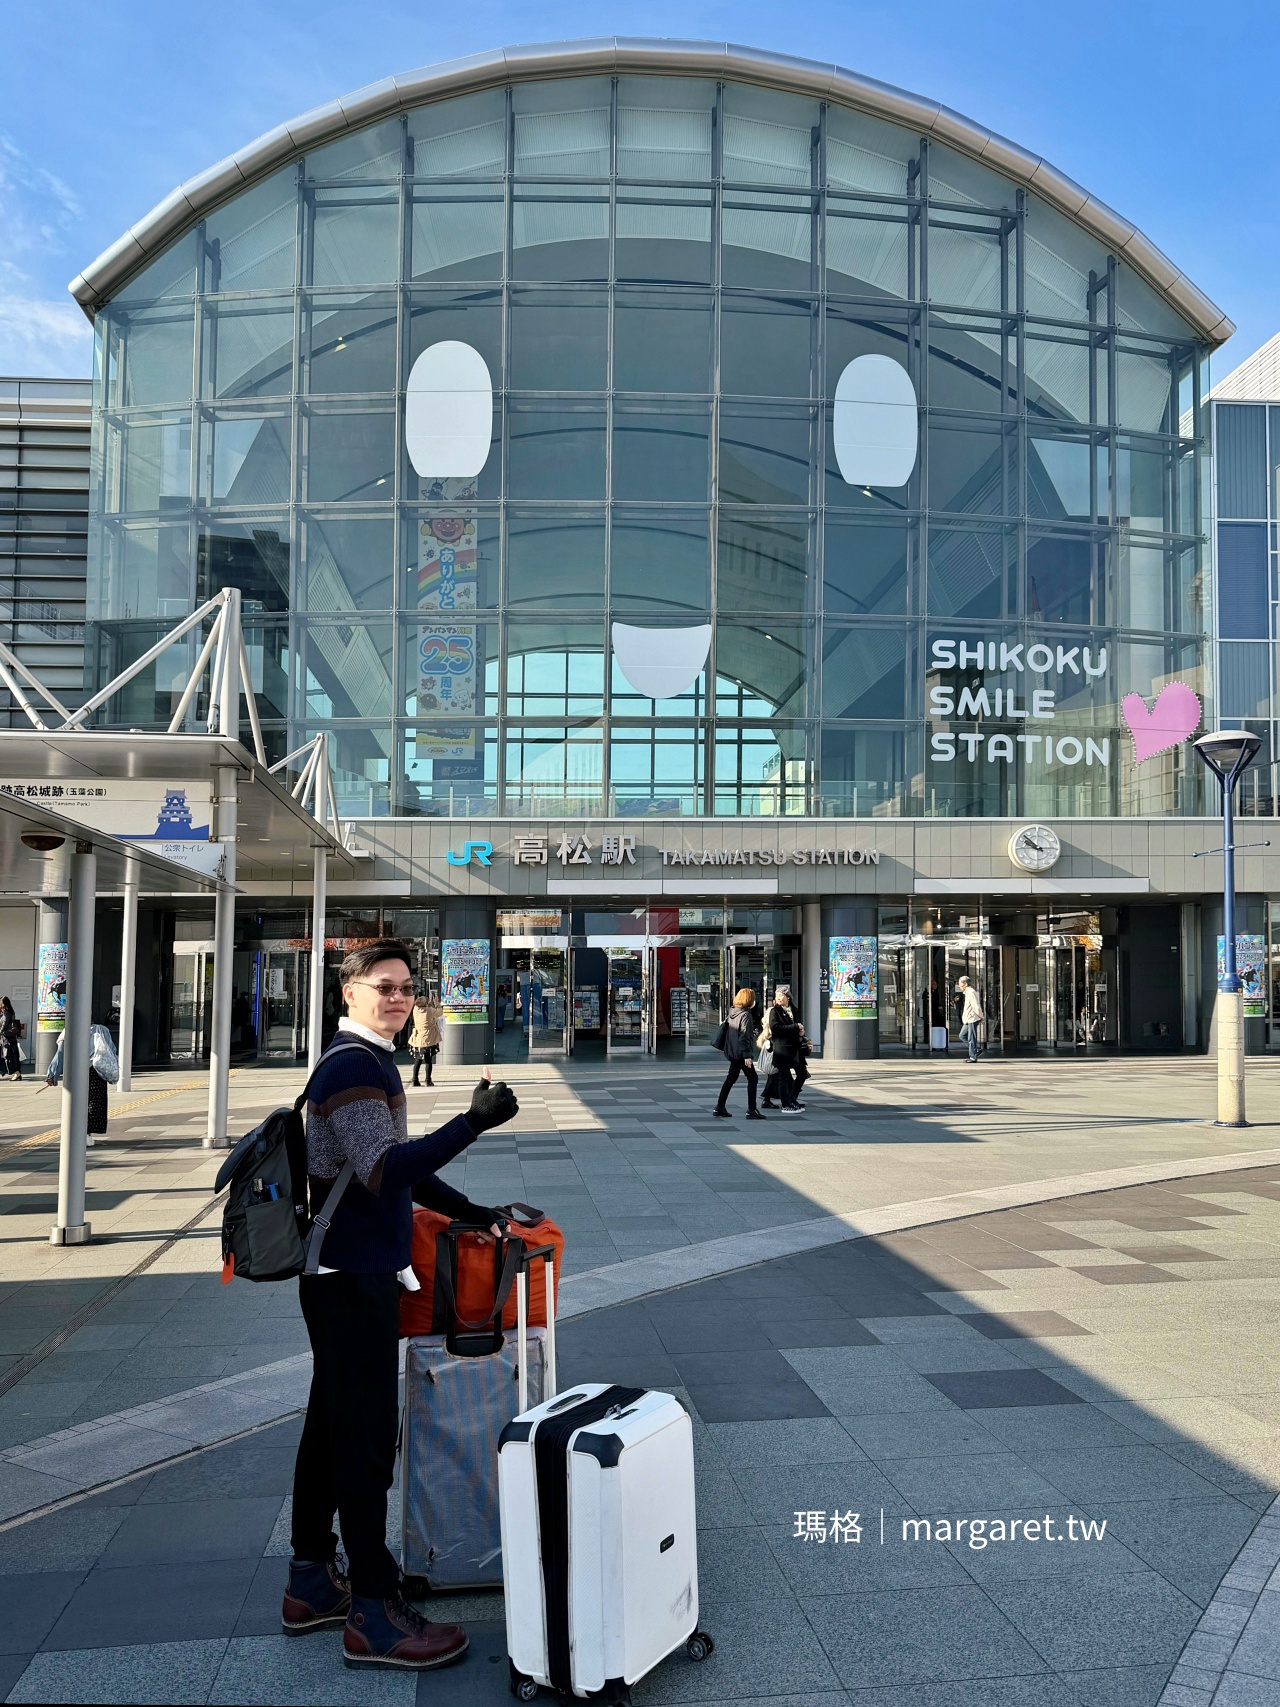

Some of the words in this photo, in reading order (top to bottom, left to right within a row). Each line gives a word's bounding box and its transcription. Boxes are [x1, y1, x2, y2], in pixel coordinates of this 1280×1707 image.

[439, 548, 455, 618] ありがと
[420, 635, 474, 675] 25
[931, 639, 1107, 676] SHIKOKU
[440, 677, 452, 700] 周年
[929, 686, 1056, 719] SMILE
[930, 732, 1110, 767] STATION
[165, 844, 204, 852] 公衆トイレ
[447, 840, 493, 866] JR
[514, 832, 637, 866] 高松駅
[659, 849, 787, 866] TAKAMATSU
[793, 849, 880, 866] STATION
